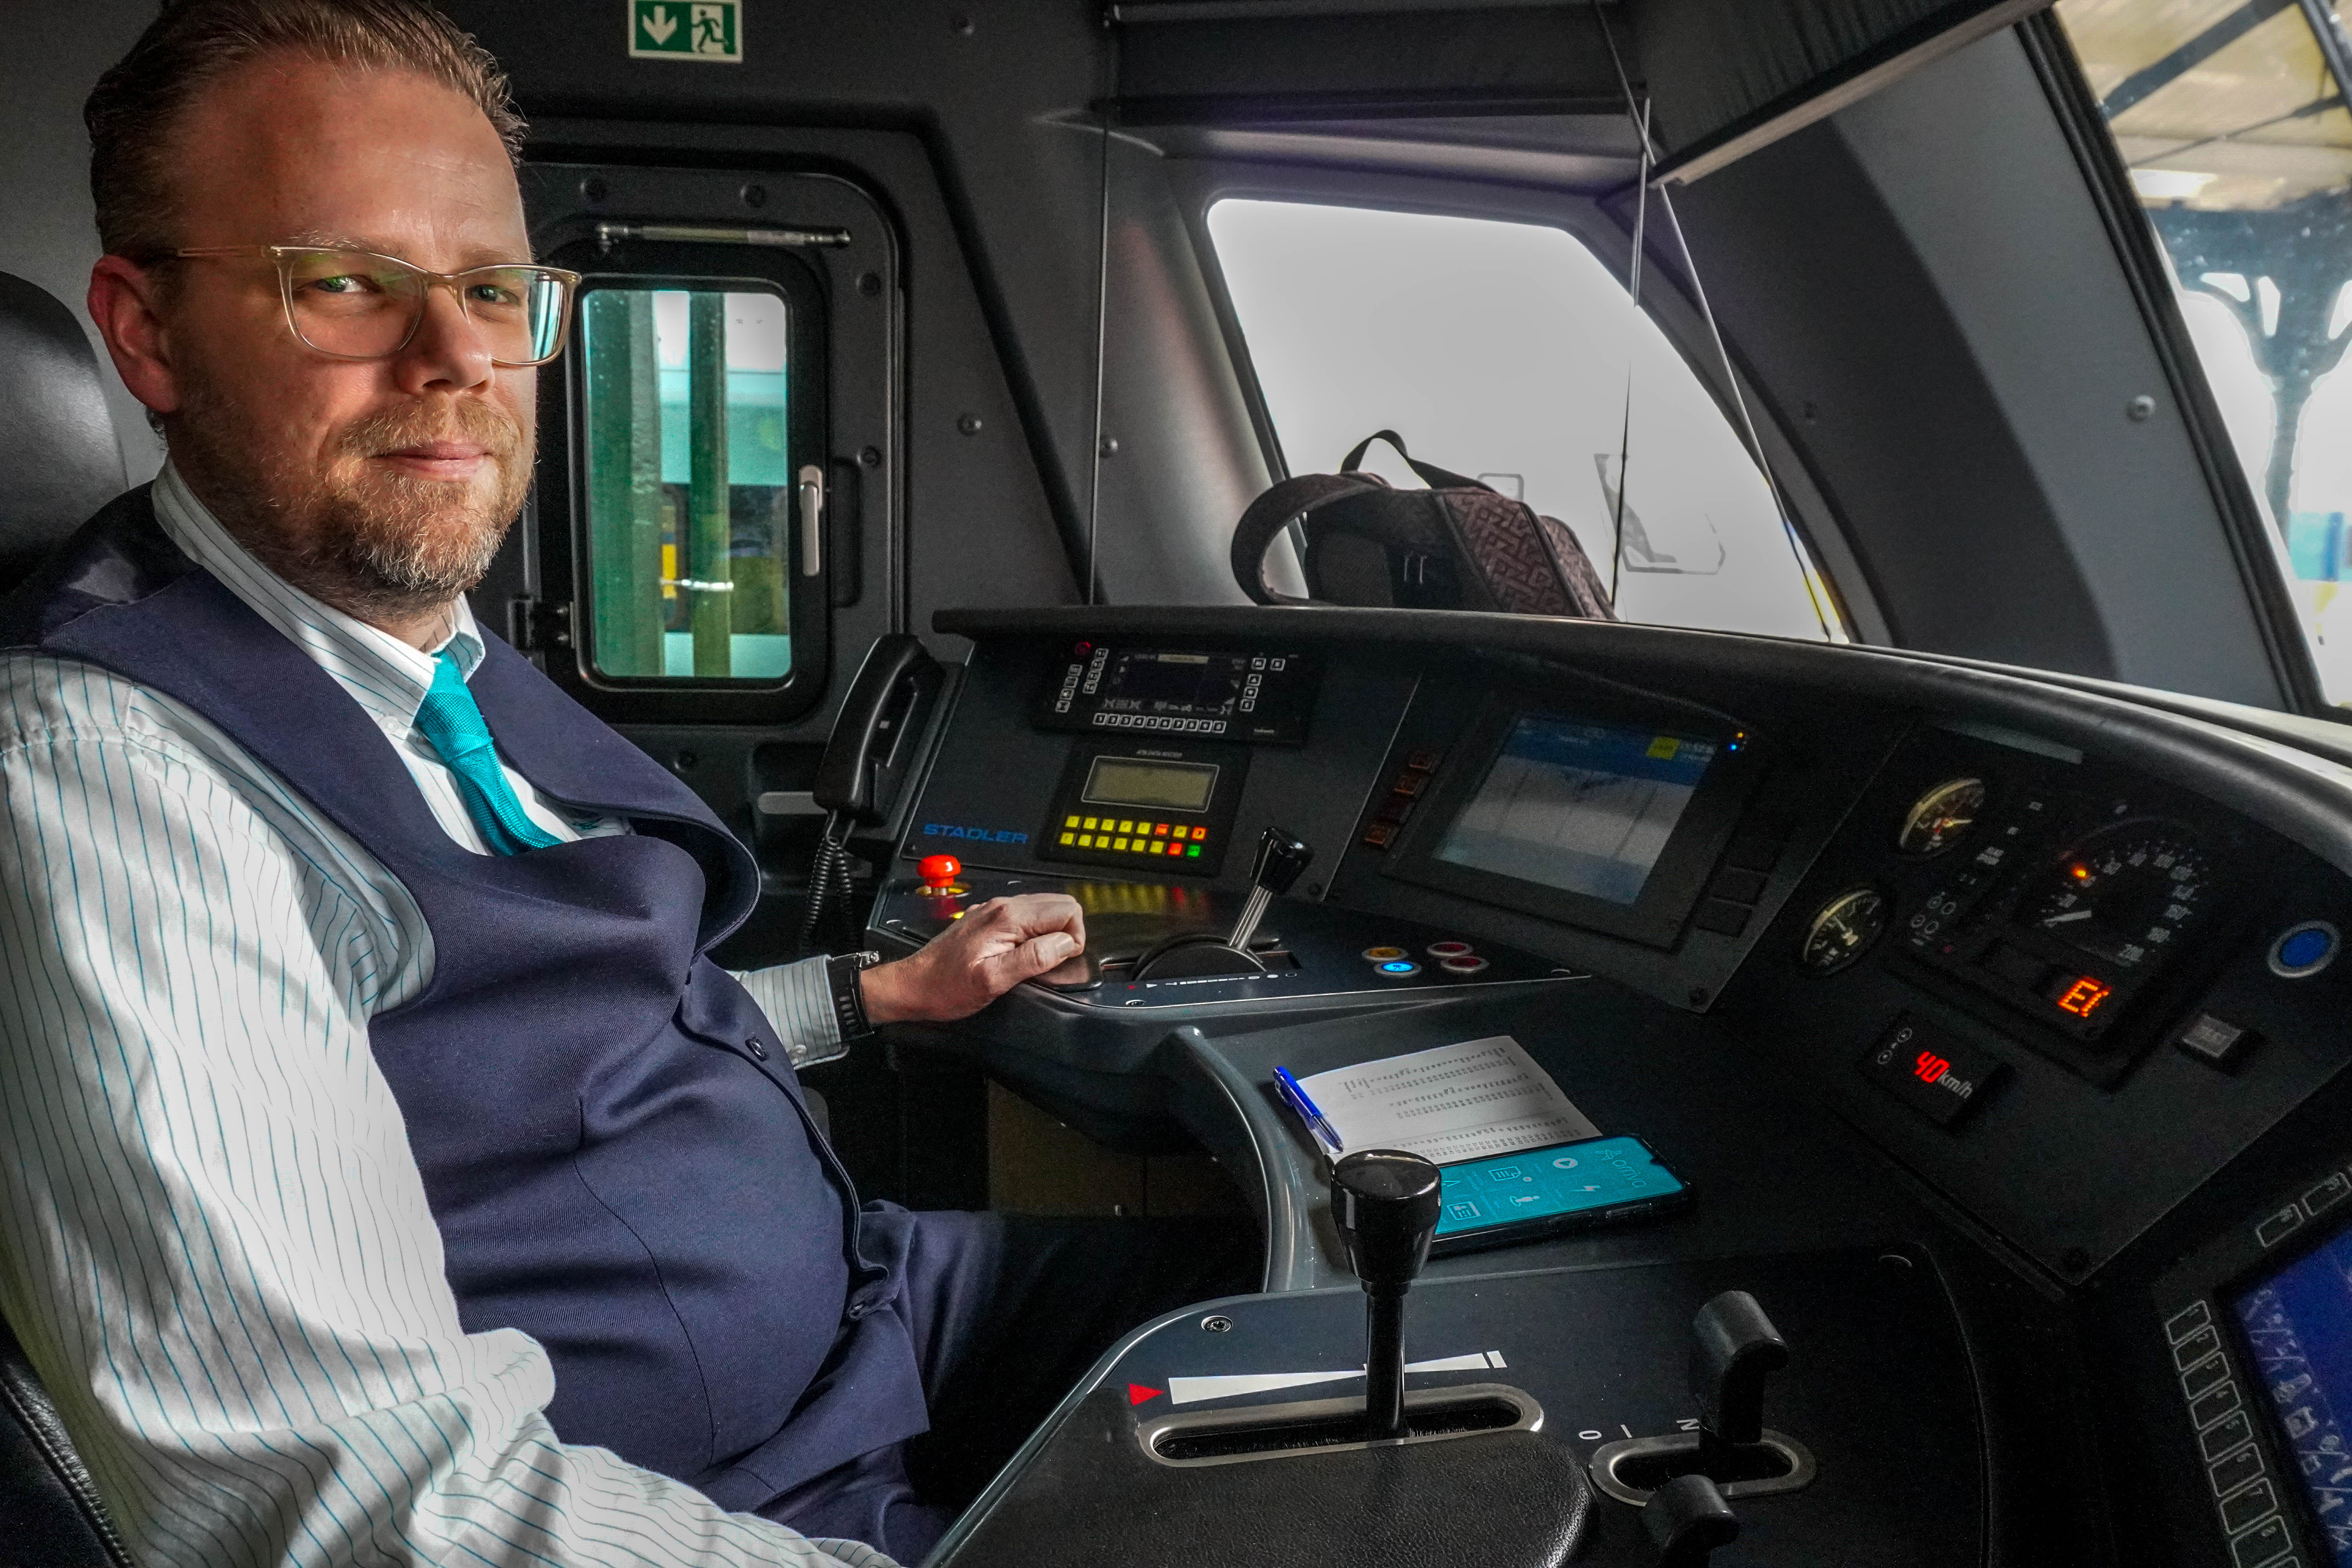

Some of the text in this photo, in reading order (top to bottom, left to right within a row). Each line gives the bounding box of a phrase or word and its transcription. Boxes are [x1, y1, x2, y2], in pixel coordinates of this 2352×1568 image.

[924, 823, 1028, 844] STADLER
[1914, 1051, 1973, 1099] 40 km/h
